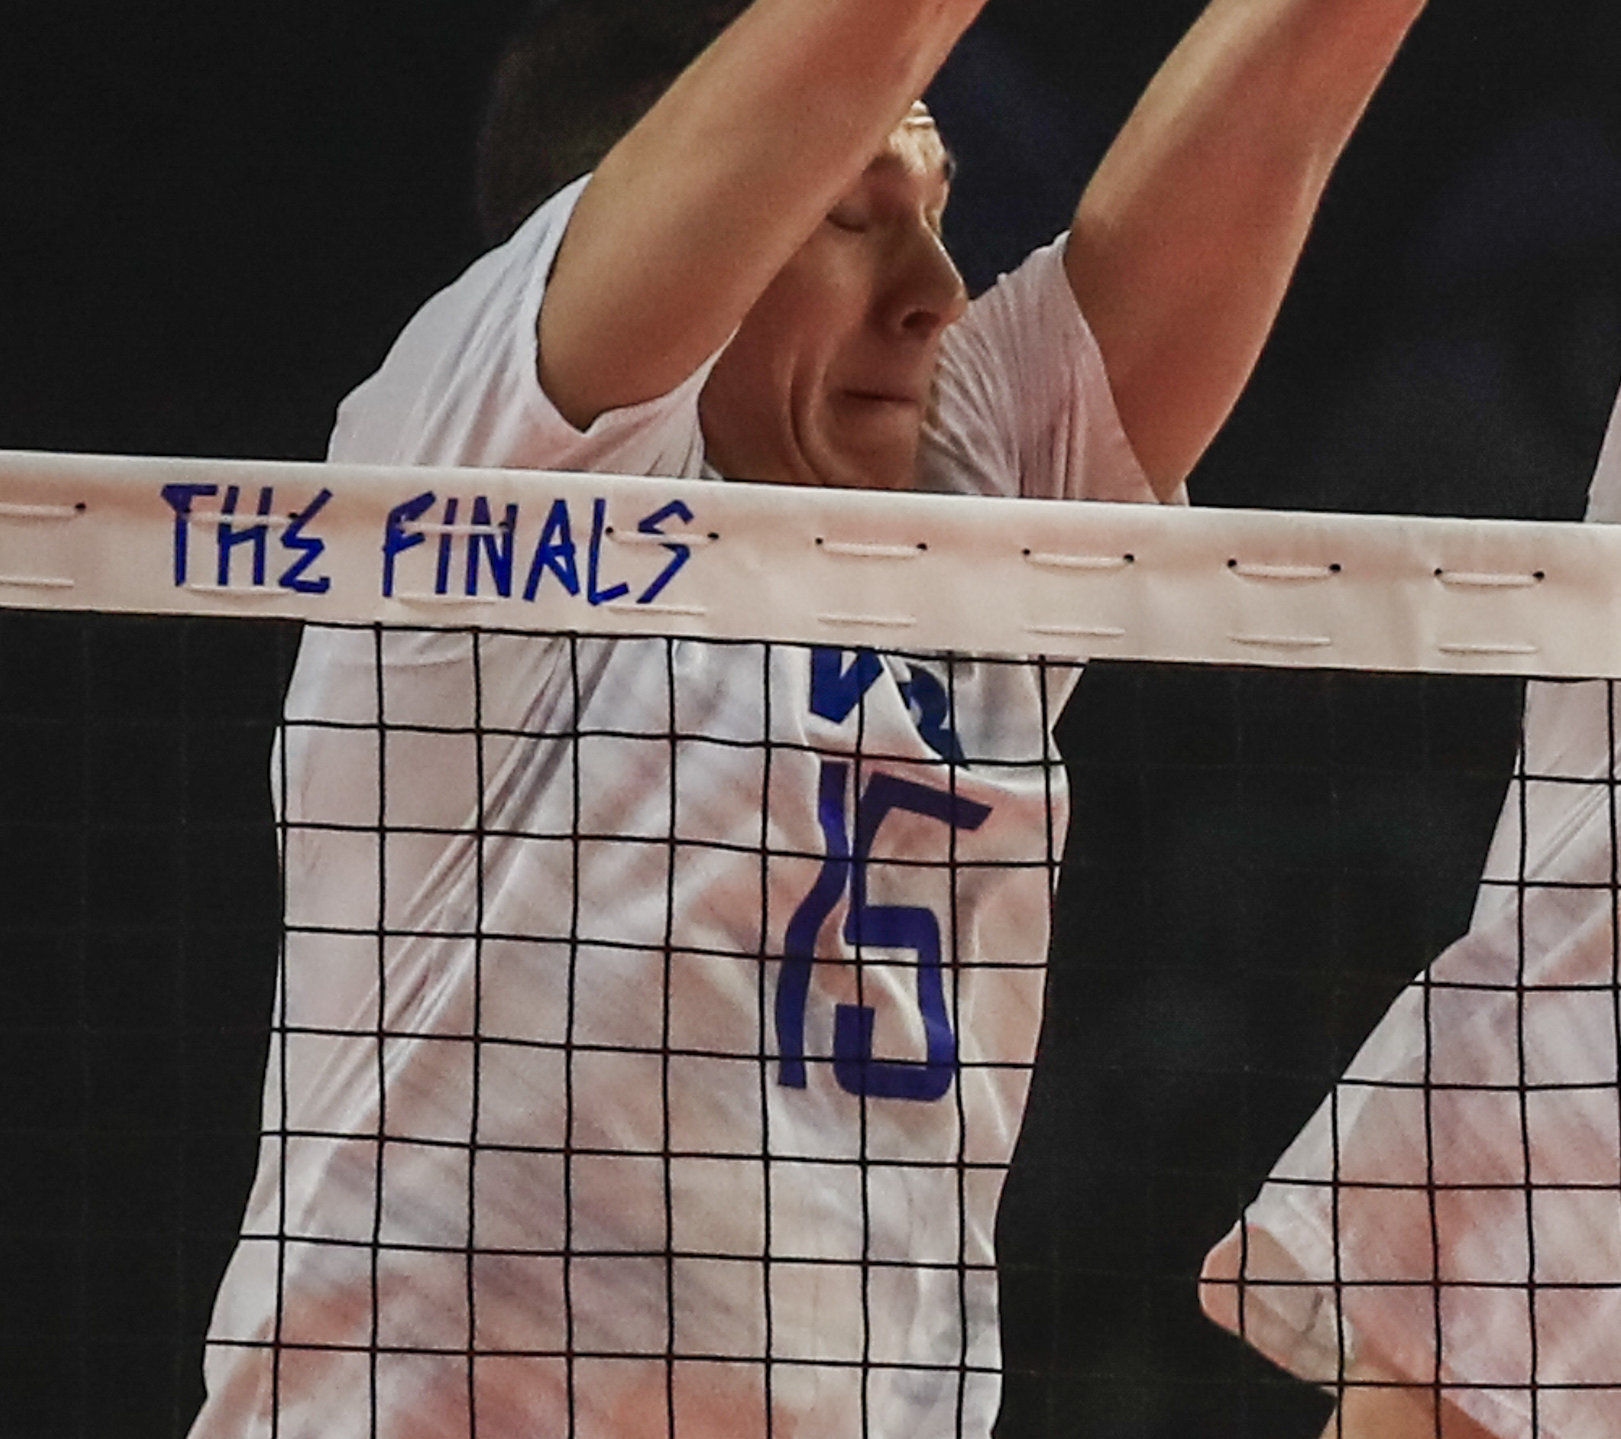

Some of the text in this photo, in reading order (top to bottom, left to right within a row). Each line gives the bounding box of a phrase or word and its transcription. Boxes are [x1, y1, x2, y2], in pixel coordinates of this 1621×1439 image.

[160, 483, 696, 605] THE FINALS
[775, 759, 993, 1102] 15
